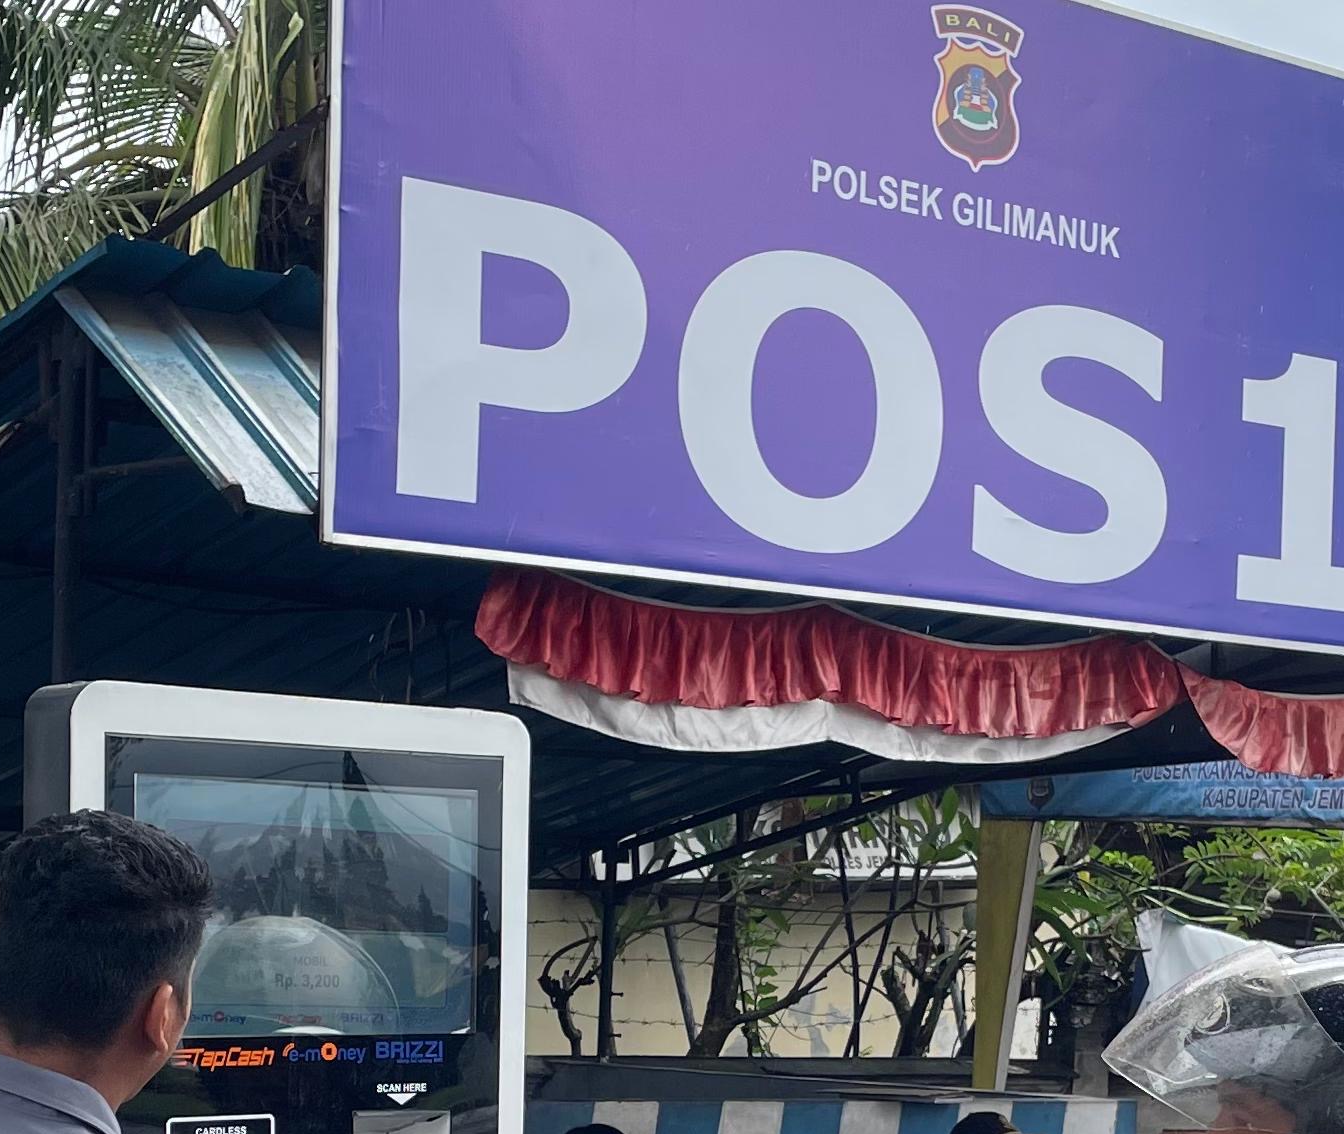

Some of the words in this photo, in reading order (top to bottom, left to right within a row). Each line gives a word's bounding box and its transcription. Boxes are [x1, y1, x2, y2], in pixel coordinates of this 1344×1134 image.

[944, 14, 1012, 43] BALI
[811, 158, 944, 221] POLSEK
[952, 191, 1121, 259] GILIMANUK
[395, 175, 1169, 586] POS
[1201, 787, 1305, 809] KABUPATEN
[301, 973, 341, 990] 3,200
[189, 1046, 275, 1072] TapCash
[374, 1040, 444, 1060] BRIZZI
[376, 1083, 402, 1094] SCAN
[402, 1082, 428, 1093] HERE
